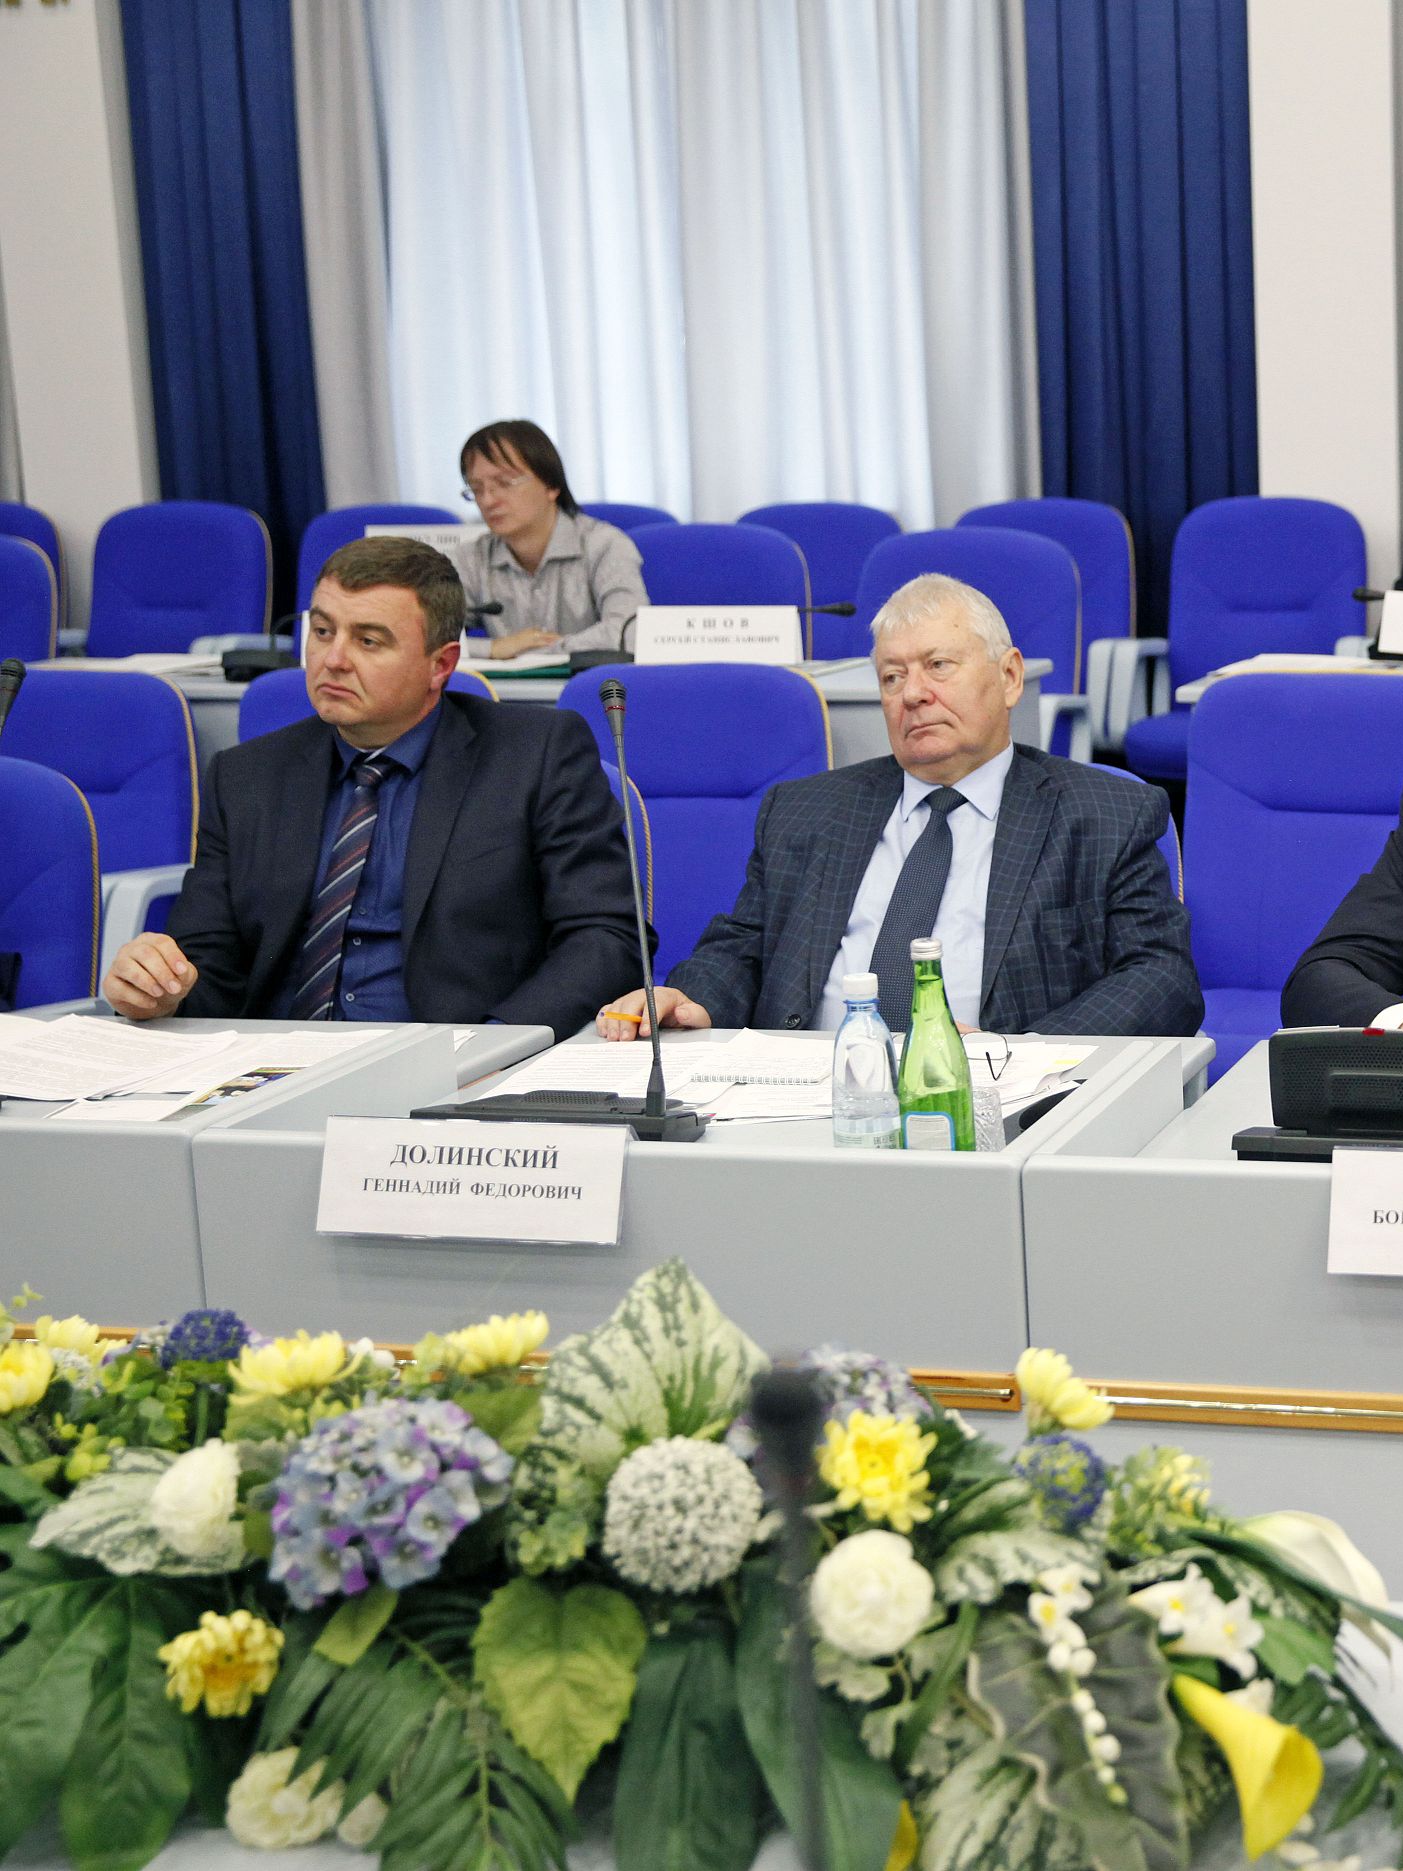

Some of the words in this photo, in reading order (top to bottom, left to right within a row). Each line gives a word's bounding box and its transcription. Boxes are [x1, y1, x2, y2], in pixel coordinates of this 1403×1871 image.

[389, 1143, 560, 1170] ДОЛИНСКИЙ
[363, 1177, 461, 1196] ГЕННАДИЙ
[470, 1181, 582, 1200] ФЕДОРОВИЧ
